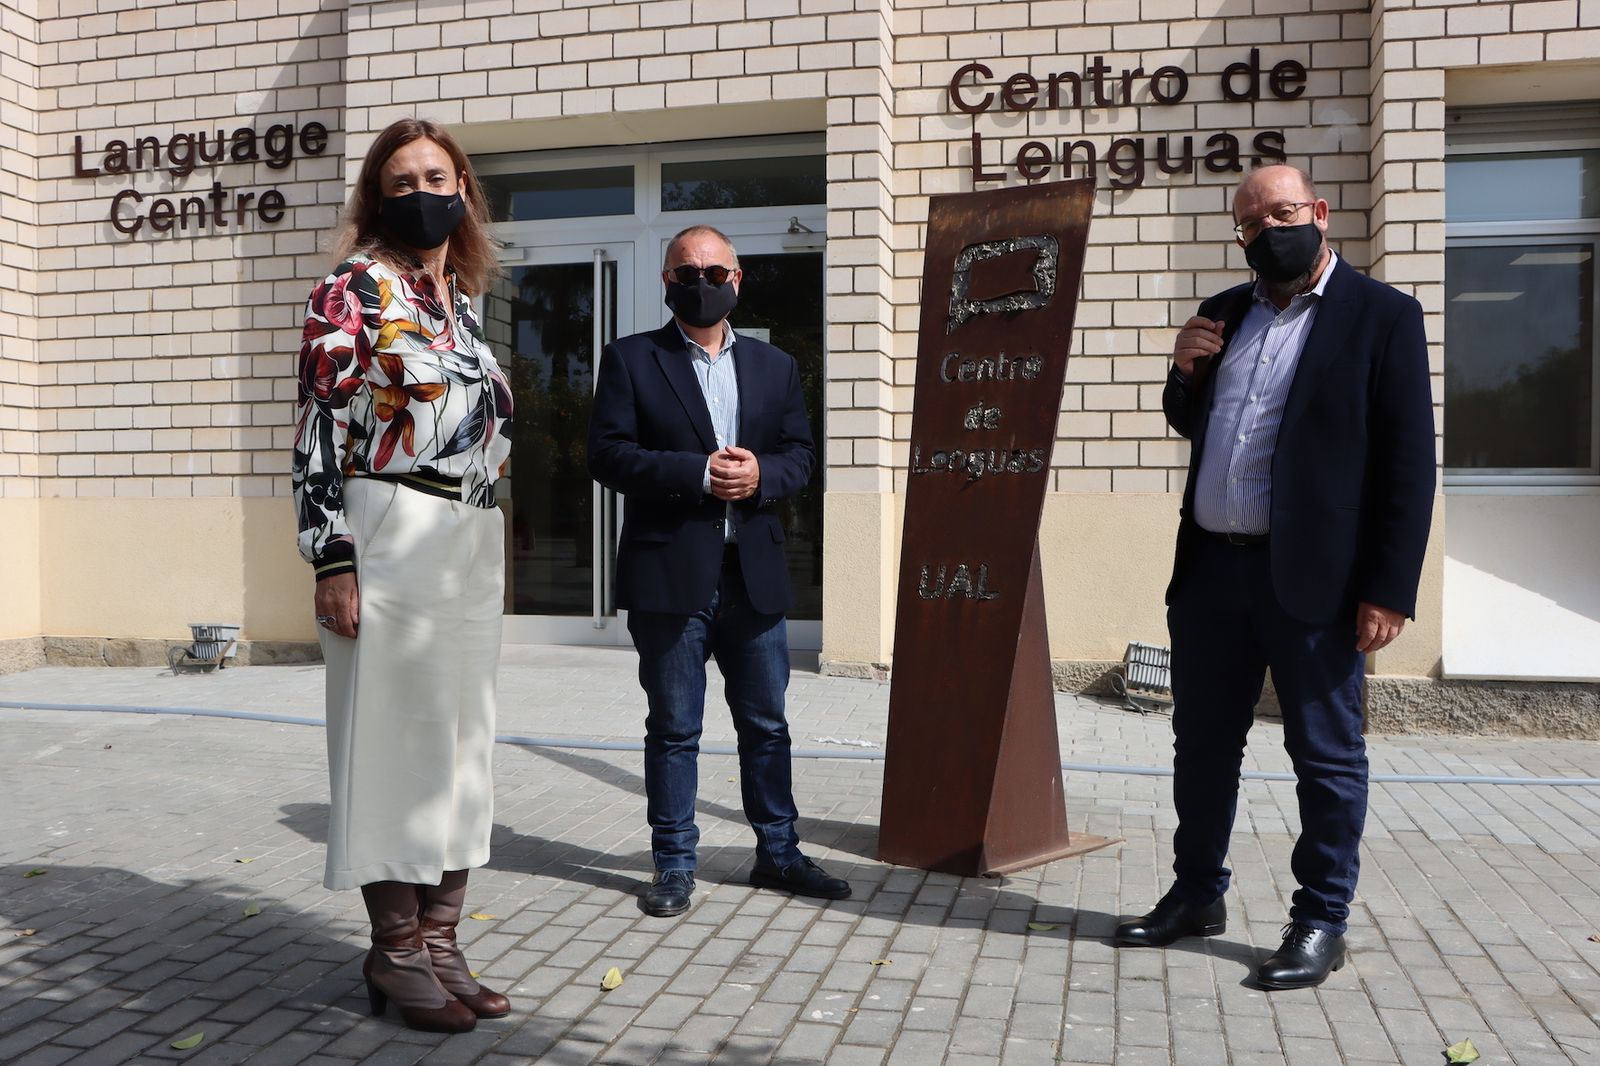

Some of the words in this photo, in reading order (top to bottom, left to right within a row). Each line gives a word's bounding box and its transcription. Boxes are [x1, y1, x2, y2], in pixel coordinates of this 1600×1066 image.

[950, 56, 1189, 114] Centro
[1221, 48, 1307, 101] de
[74, 121, 328, 178] Language
[971, 131, 1287, 189] Lenguas
[110, 182, 286, 234] Centre
[964, 401, 1001, 430] de
[919, 564, 1000, 600] UAL
